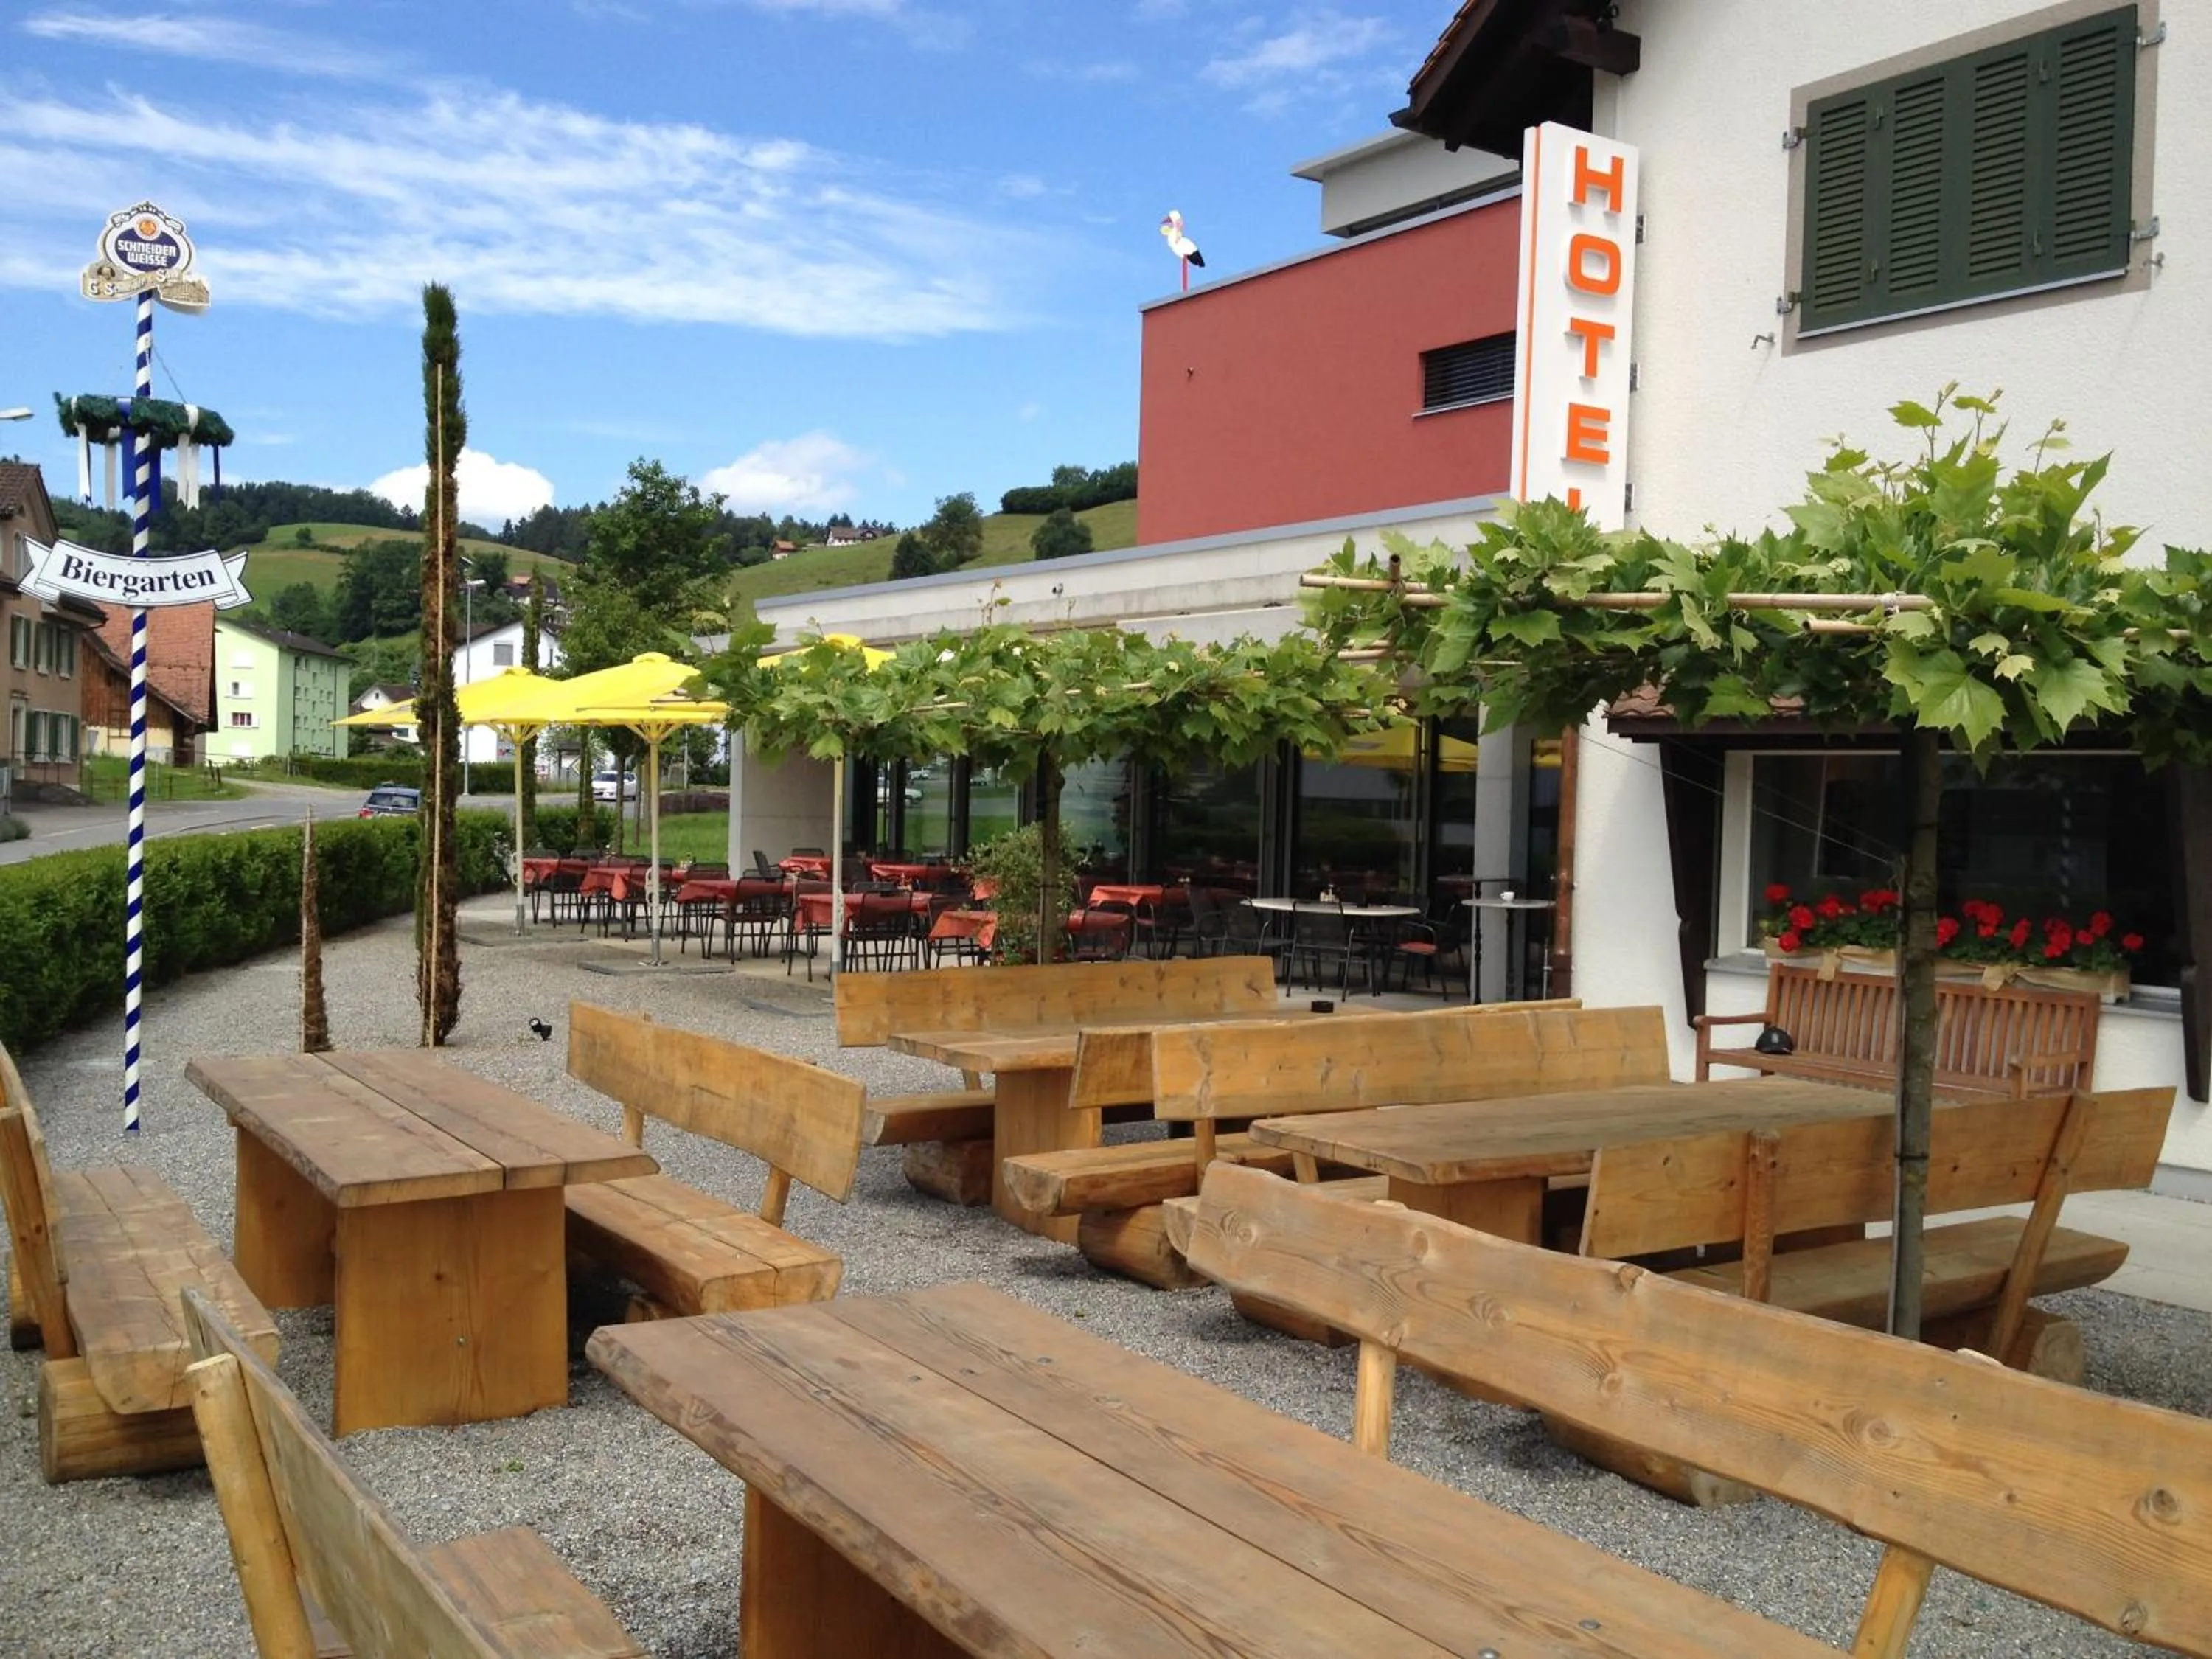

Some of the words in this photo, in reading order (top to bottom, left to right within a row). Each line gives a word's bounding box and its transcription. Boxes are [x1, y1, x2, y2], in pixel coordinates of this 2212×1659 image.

[117, 240, 176, 257] SCHNEIDER
[127, 251, 168, 266] WEISSE
[59, 554, 216, 597] Biergarten
